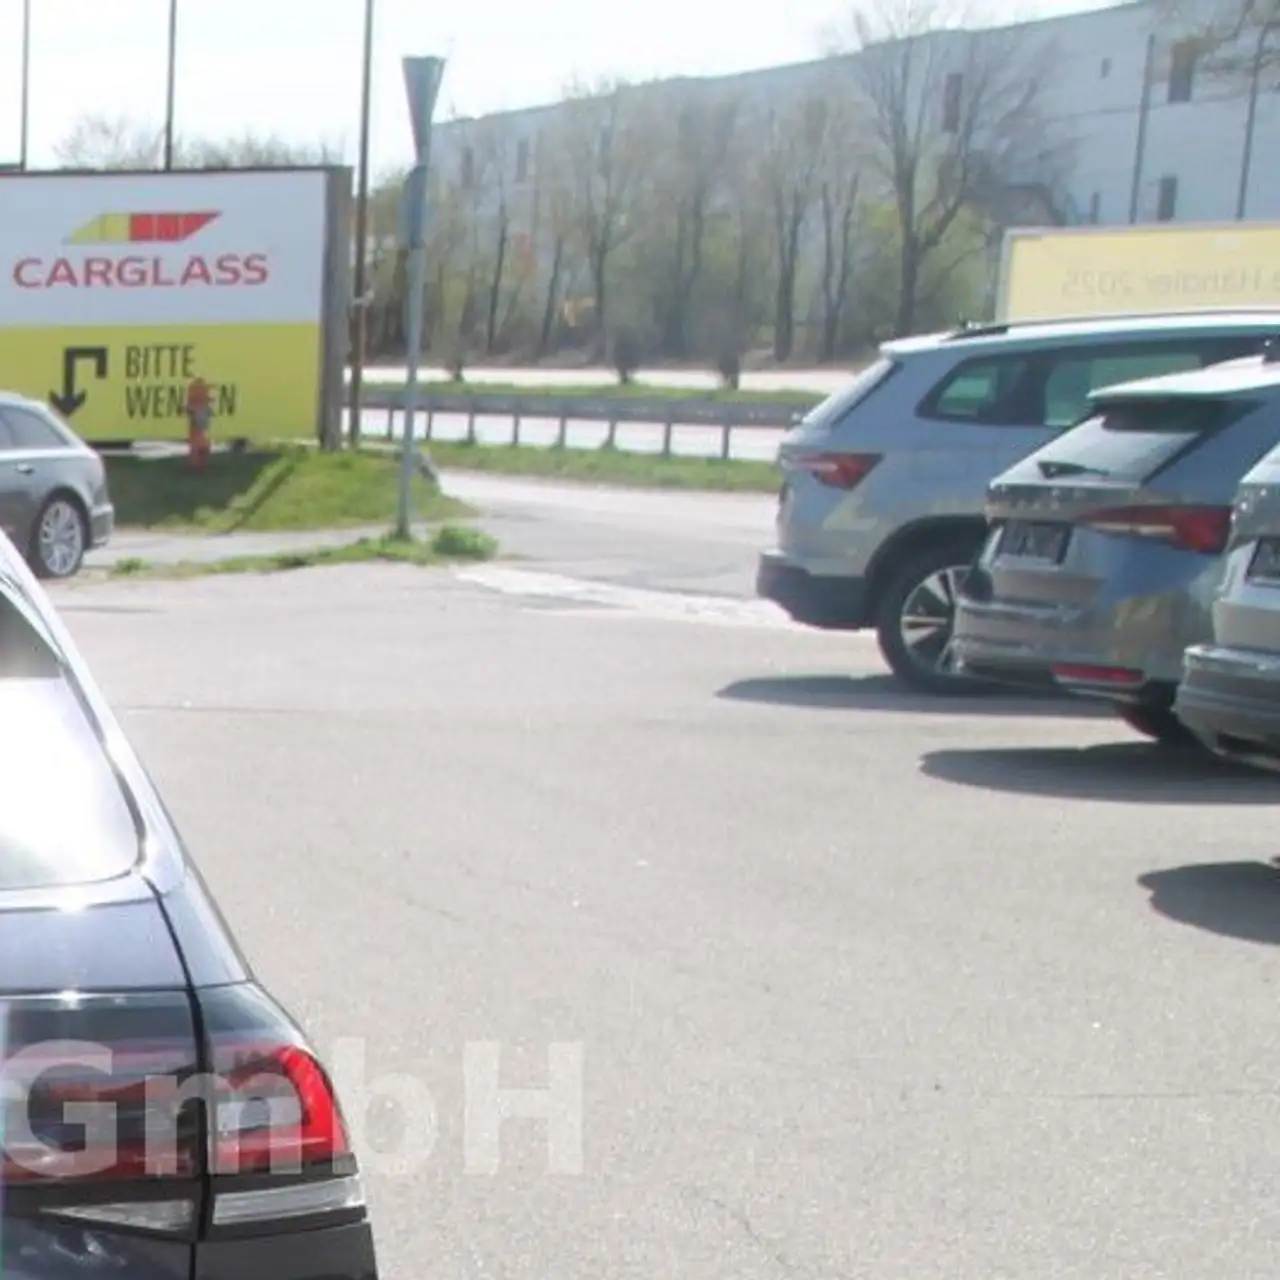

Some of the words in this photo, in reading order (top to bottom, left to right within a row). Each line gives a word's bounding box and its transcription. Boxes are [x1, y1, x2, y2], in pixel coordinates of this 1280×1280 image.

[12, 253, 269, 289] CARGLASS
[125, 344, 196, 379] BITTE
[125, 383, 237, 420] WENEN
